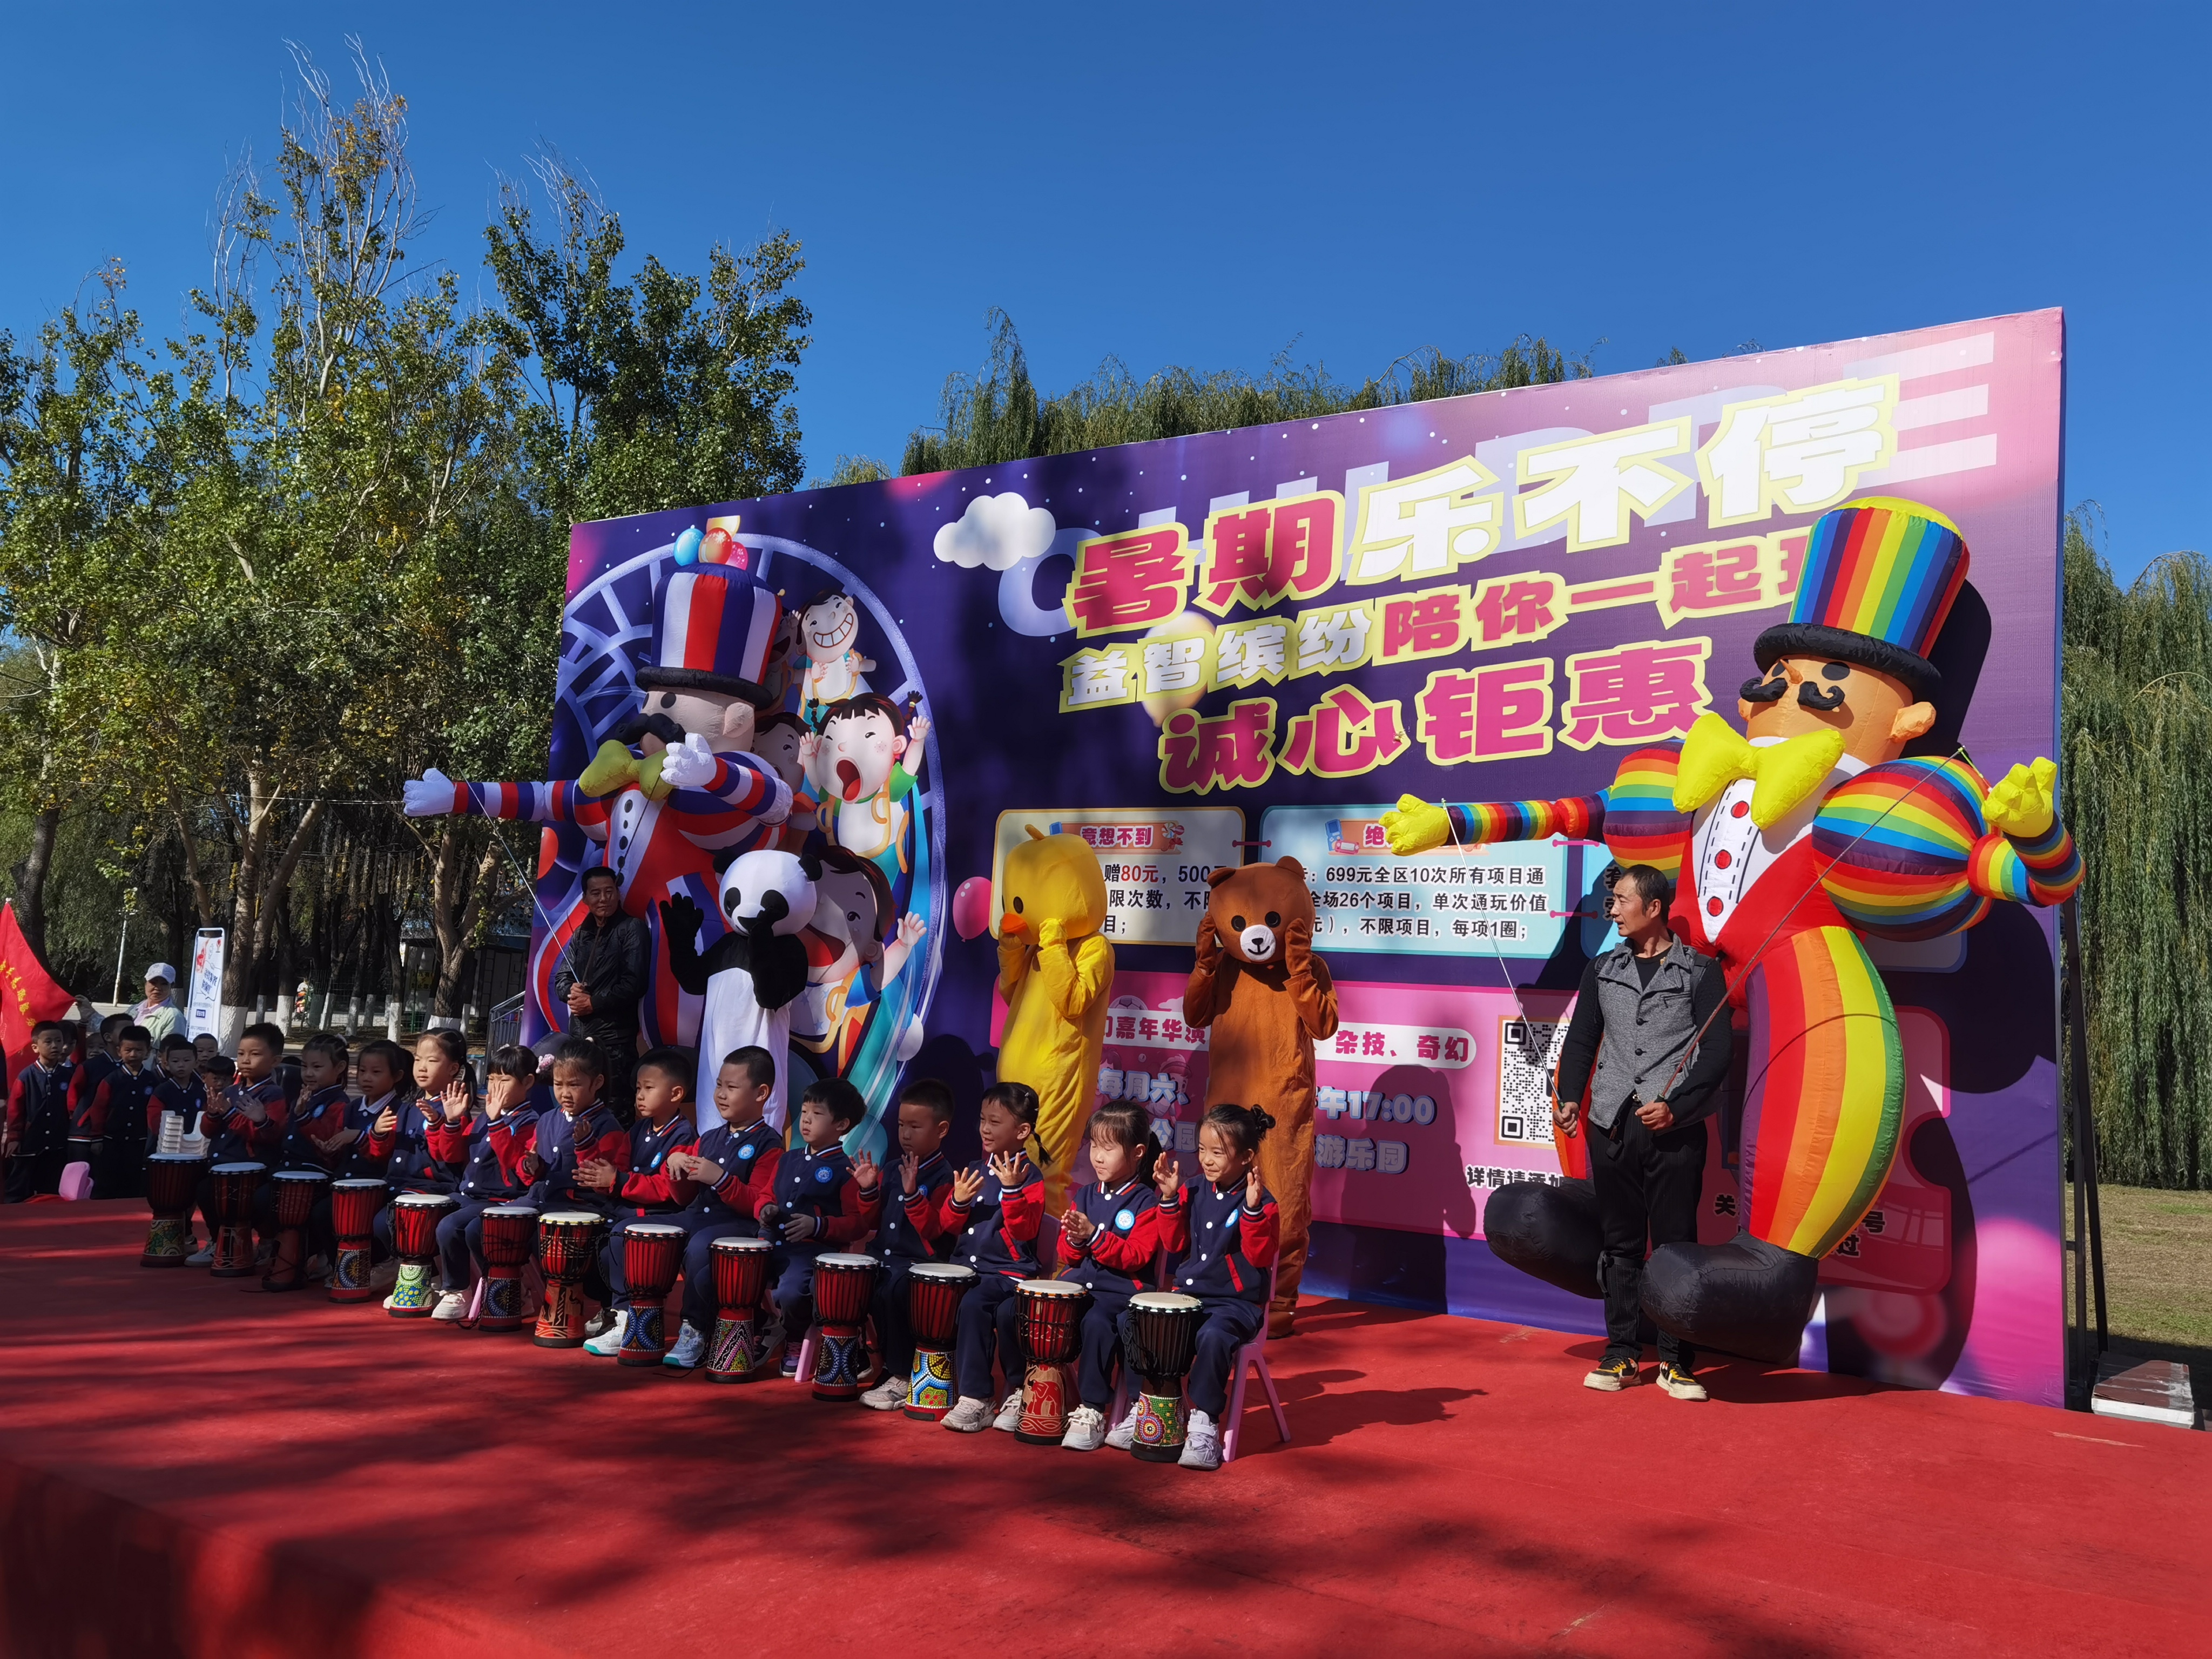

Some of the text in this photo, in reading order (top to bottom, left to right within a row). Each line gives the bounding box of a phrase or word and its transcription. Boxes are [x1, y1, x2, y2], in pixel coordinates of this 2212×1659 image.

[1070, 381, 1888, 633] 暑期乐不停
[1162, 640, 1704, 792] 诚心钜惠
[1082, 826, 1152, 846] 意想不到
[1104, 864, 1227, 884] 赠80元，500
[1109, 889, 1210, 910] 限次数，不
[1336, 1029, 1469, 1063] 杂技、奇幻
[1316, 1087, 1434, 1124] 午17:00
[1316, 1135, 1407, 1173] 游乐园
